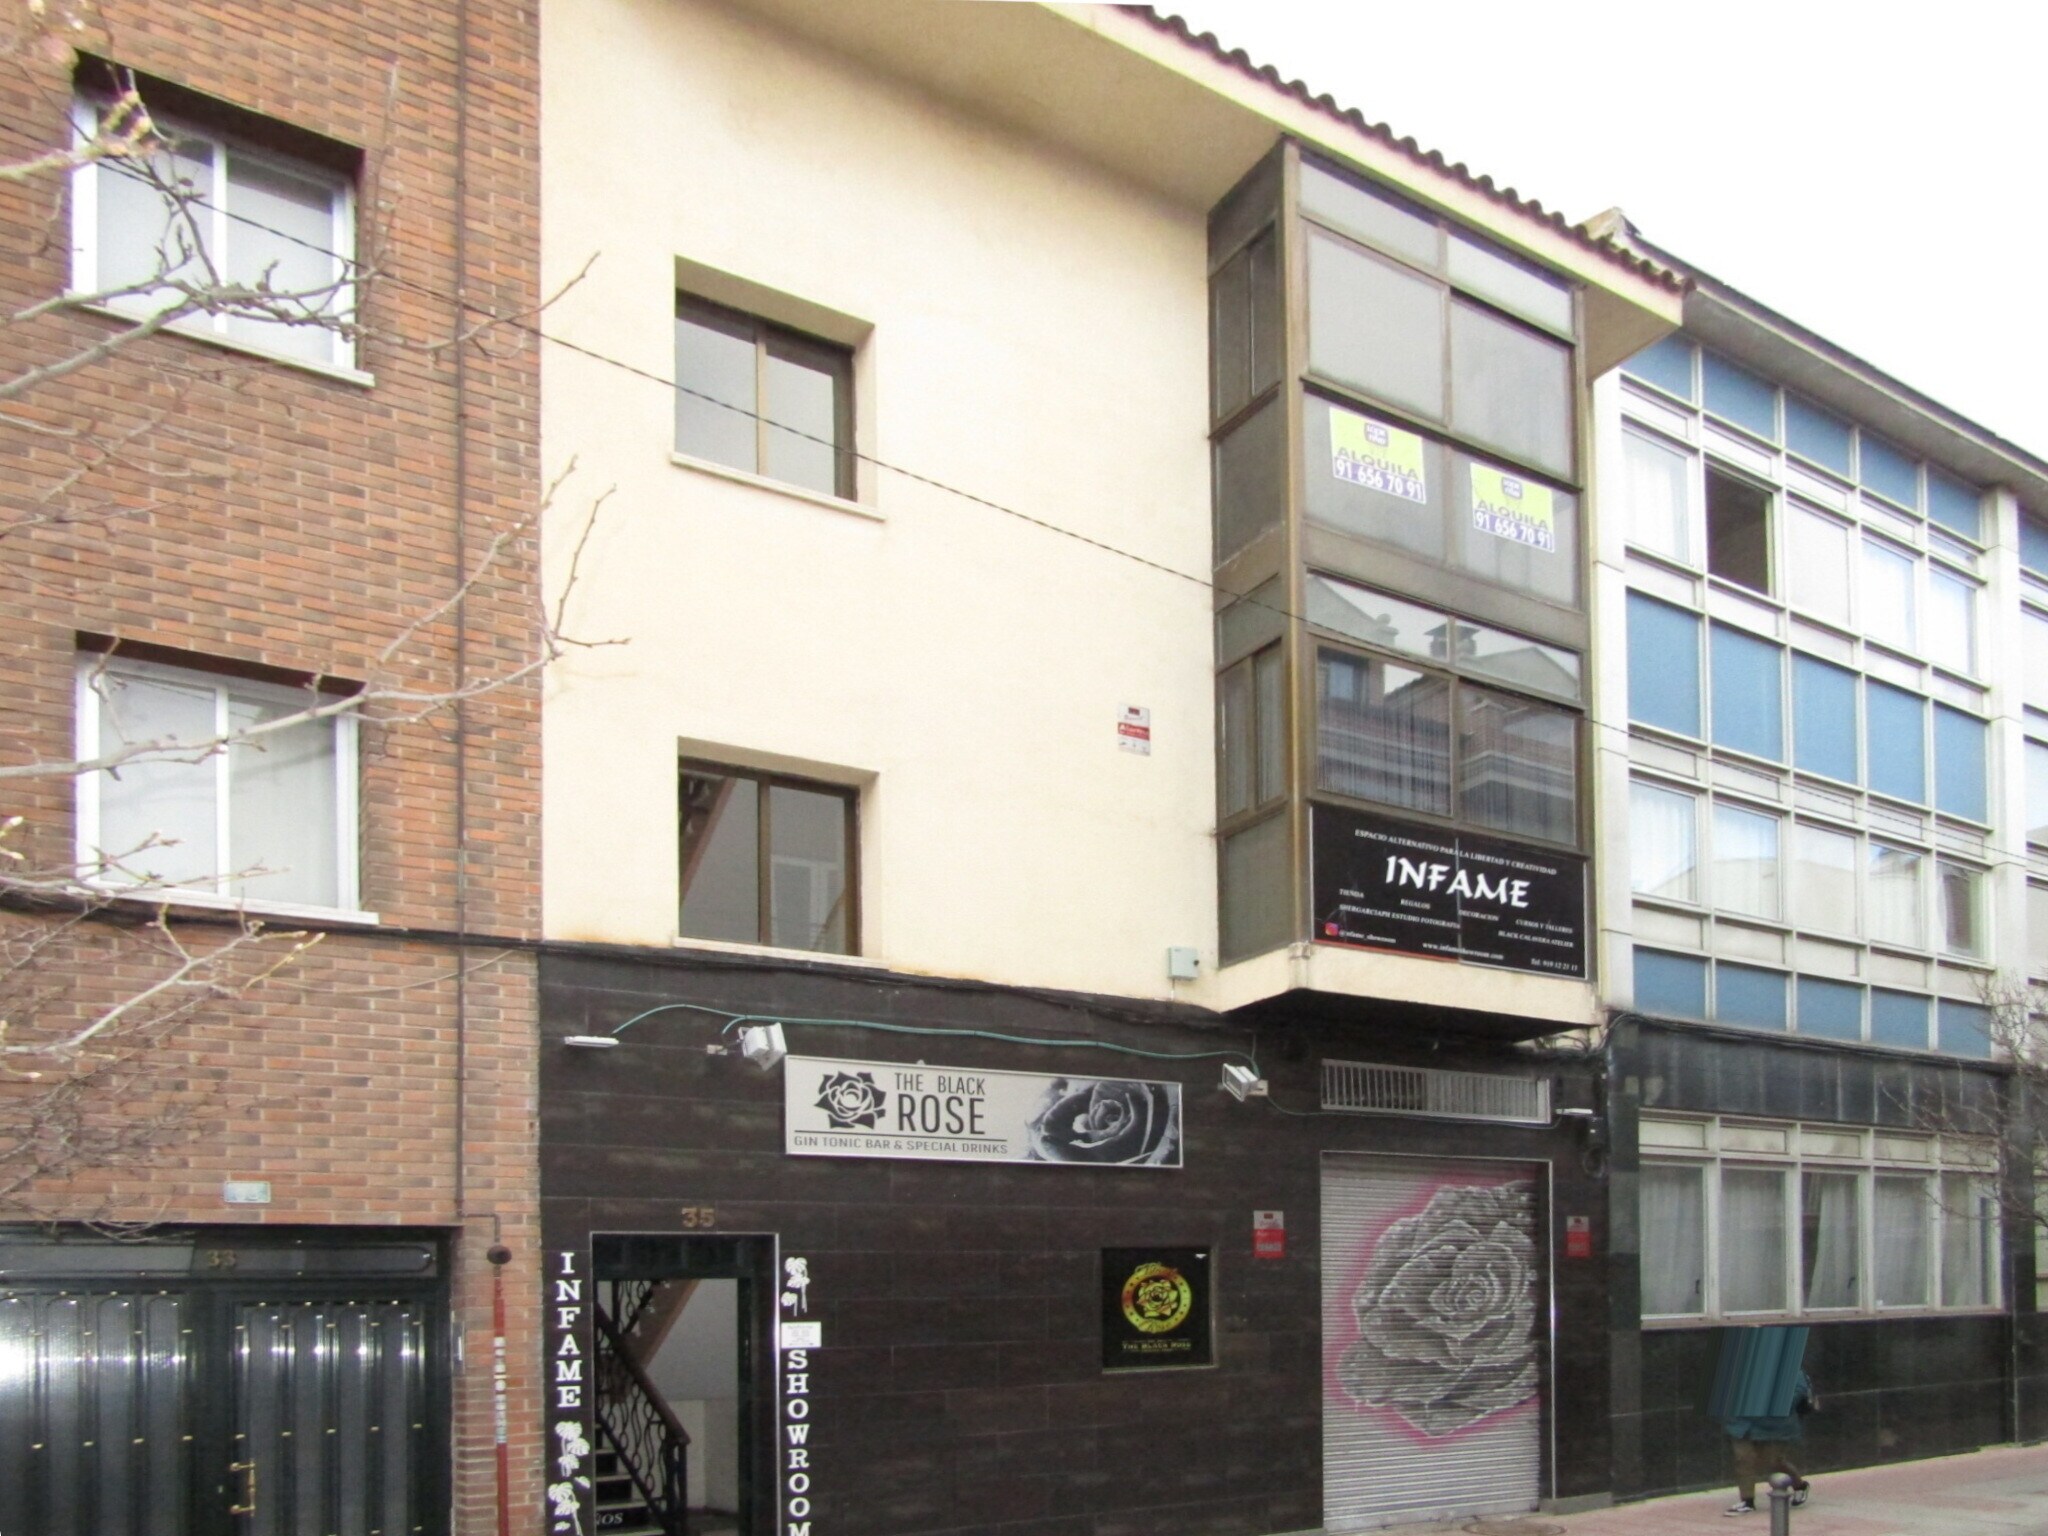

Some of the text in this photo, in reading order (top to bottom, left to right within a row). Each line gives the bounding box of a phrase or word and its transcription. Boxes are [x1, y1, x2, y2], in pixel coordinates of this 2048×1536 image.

[1336, 459, 1422, 500] 91 656 70 91
[1337, 447, 1419, 480] ALQUILA
[1476, 511, 1551, 548] 91 656 70 91
[1478, 500, 1548, 530] ALQUILA
[1354, 829, 1557, 875] ESPACIO ALTERNATIVO PARA LA LIBERTAD Y CREATIVIDAD
[1385, 855, 1531, 909] INFAME
[1339, 889, 1365, 899] TIENDA
[1400, 899, 1431, 909] REGALOS
[1391, 912, 1420, 923] ESTUDIO
[894, 1072, 986, 1096] THE BLACK
[899, 1095, 986, 1136] ROSE
[794, 1135, 1008, 1154] GIN TONIC BAR & SPECIAL DRINKS
[681, 1207, 716, 1228] 35
[207, 1250, 236, 1266] 33
[555, 1252, 582, 1408] INFAME
[786, 1349, 812, 1536] SHOWROOM
